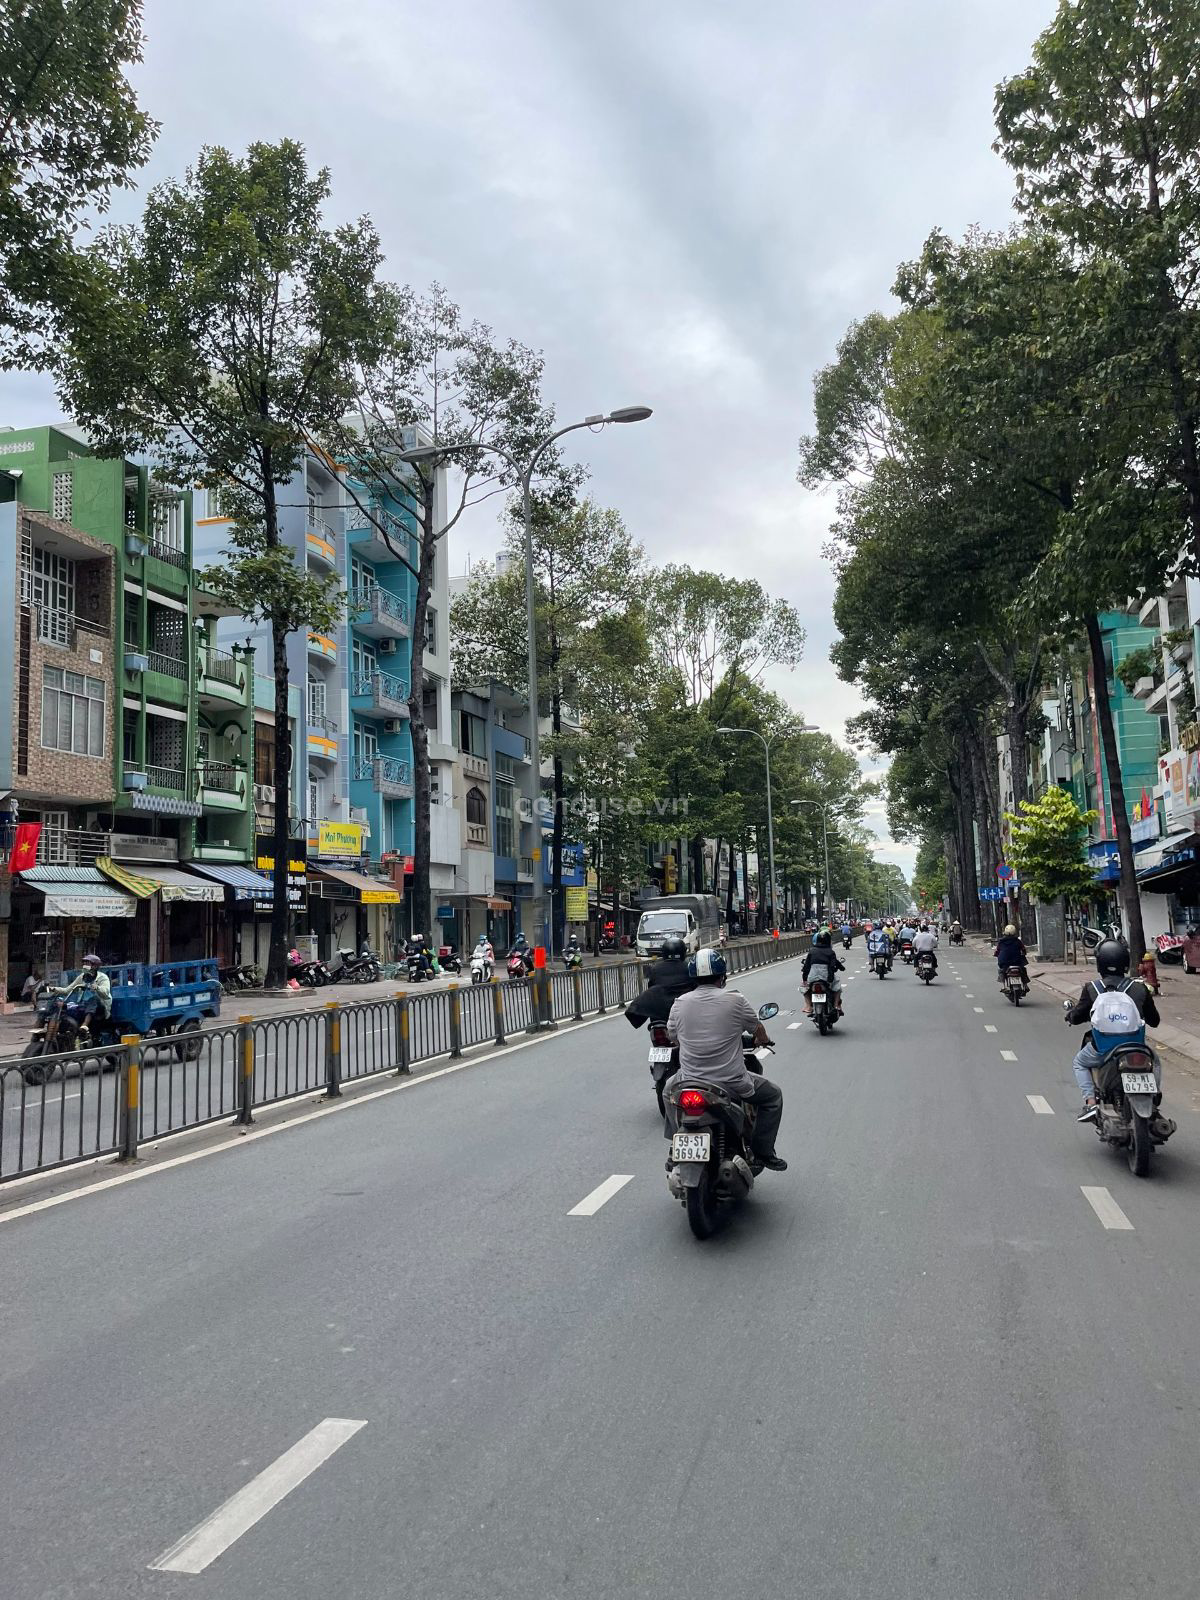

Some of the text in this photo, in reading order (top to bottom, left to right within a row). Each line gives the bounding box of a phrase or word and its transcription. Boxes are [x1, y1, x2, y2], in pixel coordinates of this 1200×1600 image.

[1108, 1013, 1128, 1022] yola
[678, 1136, 704, 1147] 59-S1
[675, 1148, 708, 1160] 369.42
